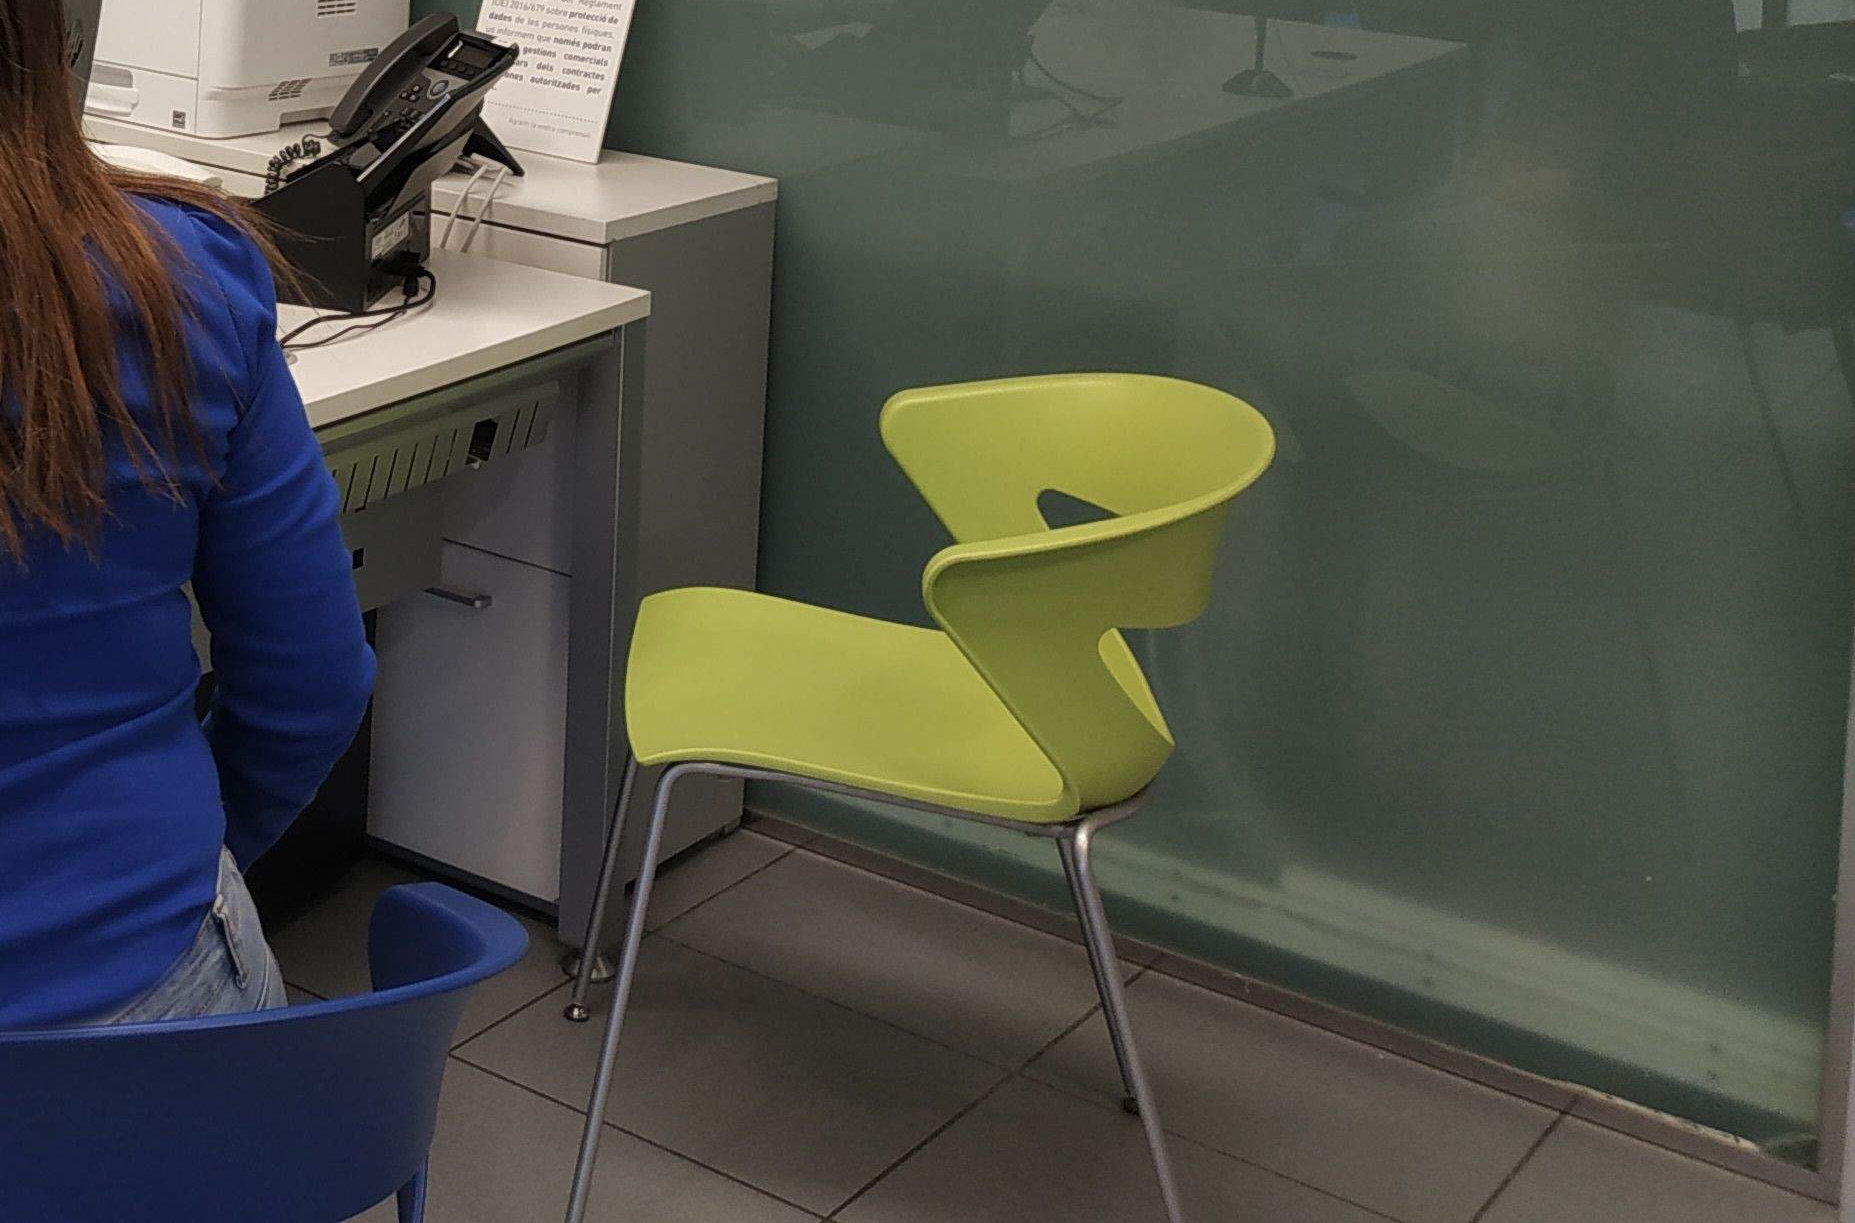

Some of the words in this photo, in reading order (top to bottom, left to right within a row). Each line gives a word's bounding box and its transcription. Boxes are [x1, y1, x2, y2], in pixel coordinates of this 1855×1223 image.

[488, 12, 512, 22] dades
[514, 16, 525, 24] de
[542, 21, 578, 33] persones
[569, 11, 607, 23] protecció
[608, 16, 619, 24] de
[497, 28, 534, 40] informem
[553, 37, 580, 47] només
[582, 42, 612, 52] podran
[523, 46, 557, 58] gestions
[563, 53, 609, 66] comercials
[536, 62, 554, 72] dels
[562, 68, 605, 81] contractes
[530, 76, 580, 91] autoritzades
[587, 86, 602, 95] per
